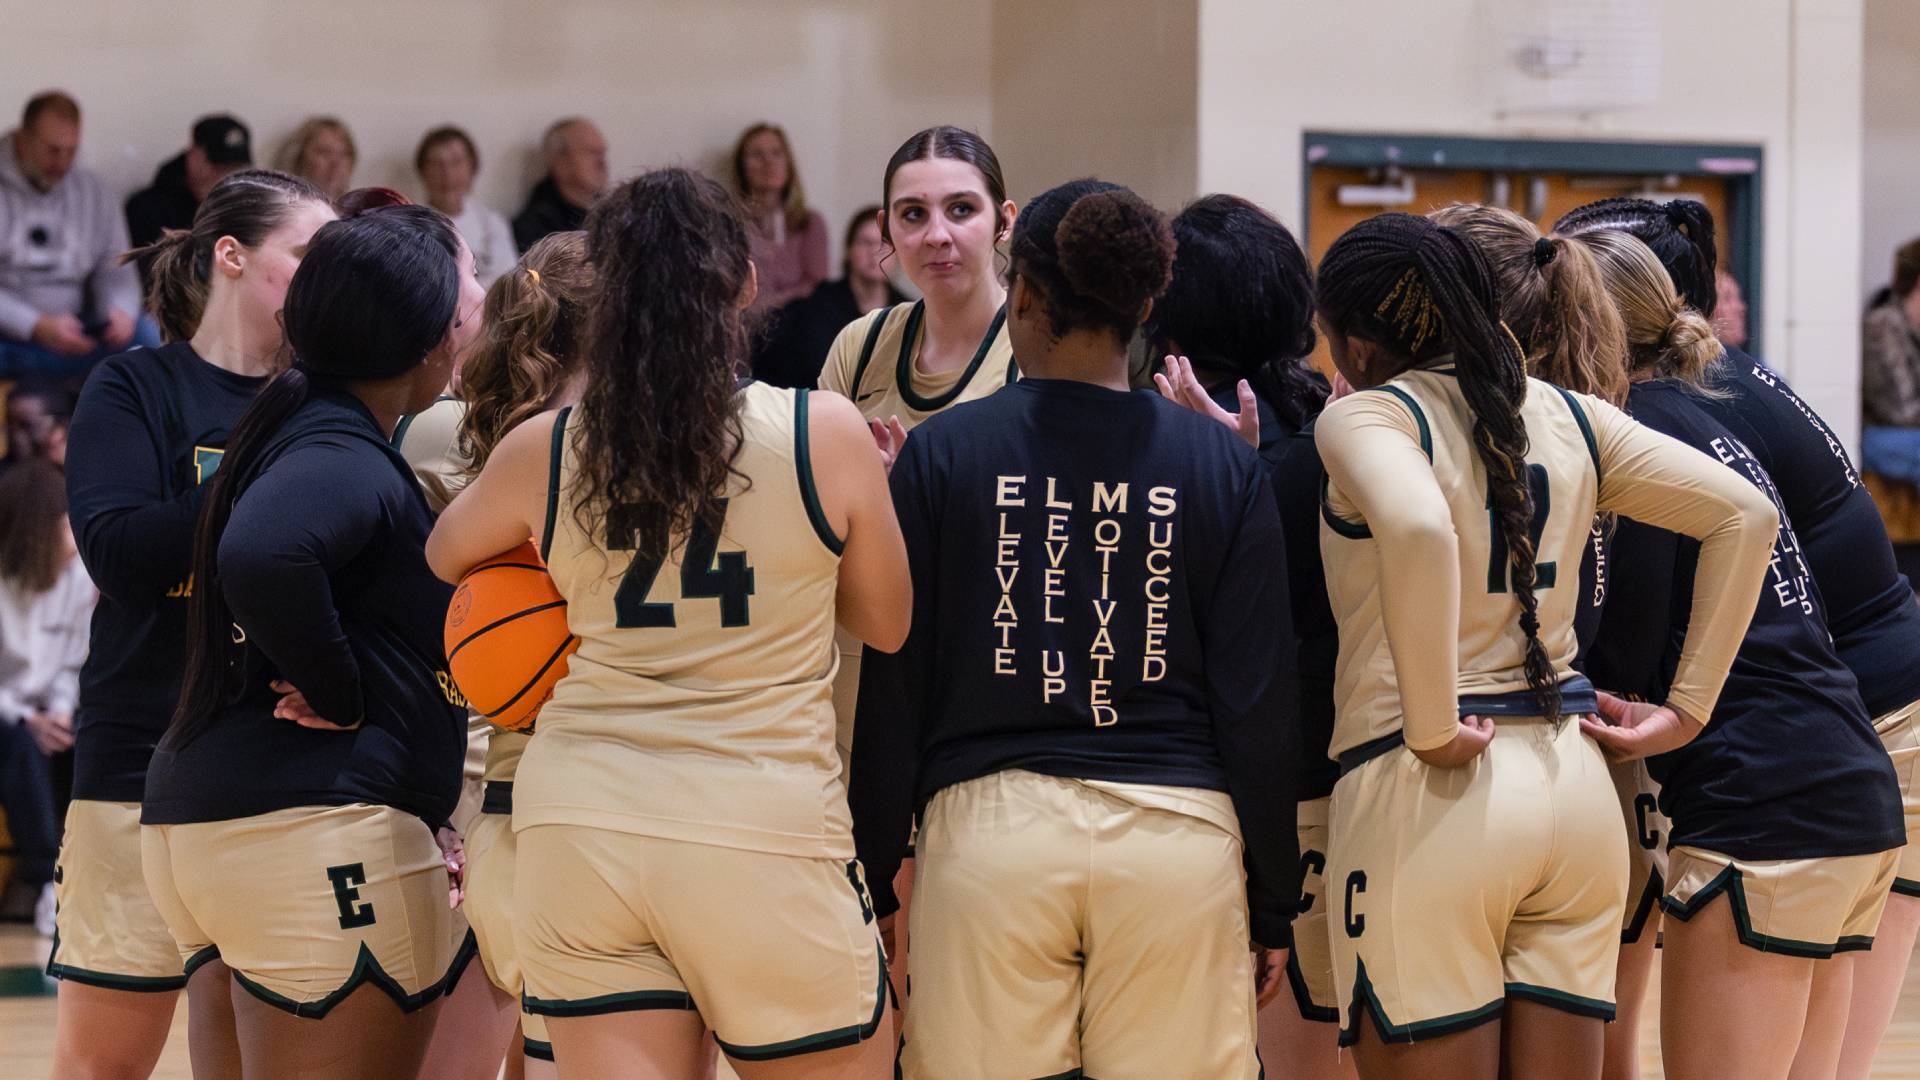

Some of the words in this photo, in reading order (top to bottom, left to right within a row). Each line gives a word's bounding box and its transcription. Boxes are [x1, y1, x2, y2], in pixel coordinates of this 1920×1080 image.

[606, 497, 755, 628] 24
[993, 475, 1026, 675] ELEVATE
[1044, 477, 1072, 624] LEVEL
[1142, 486, 1177, 682] SUCCEED
[1090, 482, 1129, 727] MOTIVATED
[1042, 650, 1066, 703] UP
[1634, 793, 1659, 850] C
[326, 862, 377, 930] E
[1299, 849, 1326, 914] C
[1344, 869, 1368, 938] C
